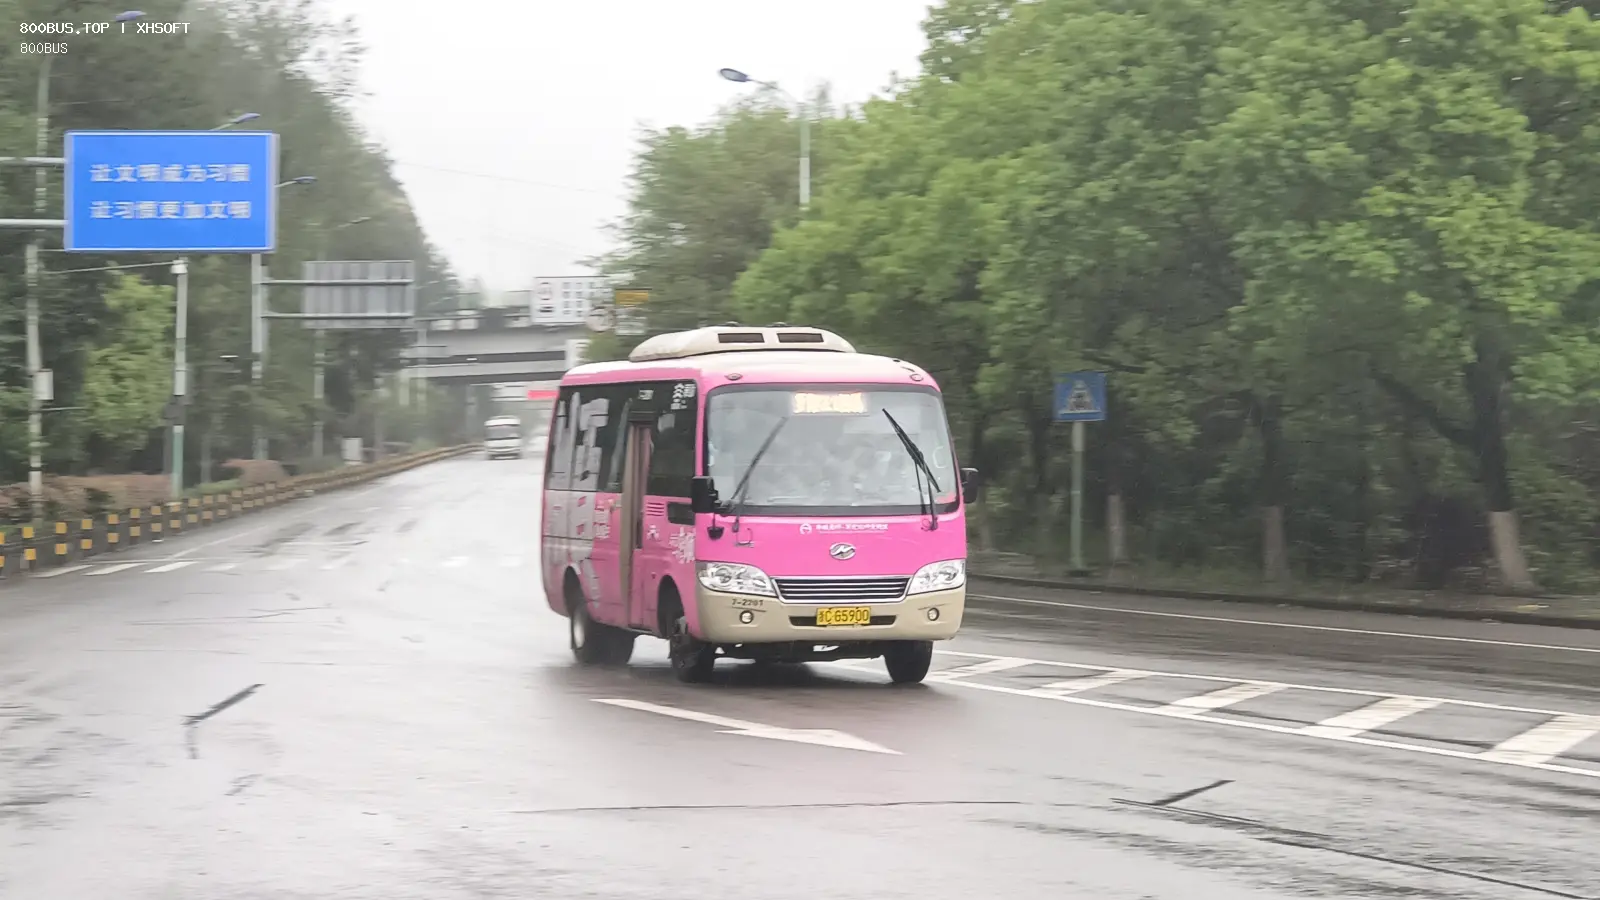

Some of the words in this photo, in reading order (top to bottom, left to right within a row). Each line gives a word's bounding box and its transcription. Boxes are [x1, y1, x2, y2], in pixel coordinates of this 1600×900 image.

[89, 163, 250, 182] 让文明成为习惯
[89, 200, 251, 219] 让习惯更加文明
